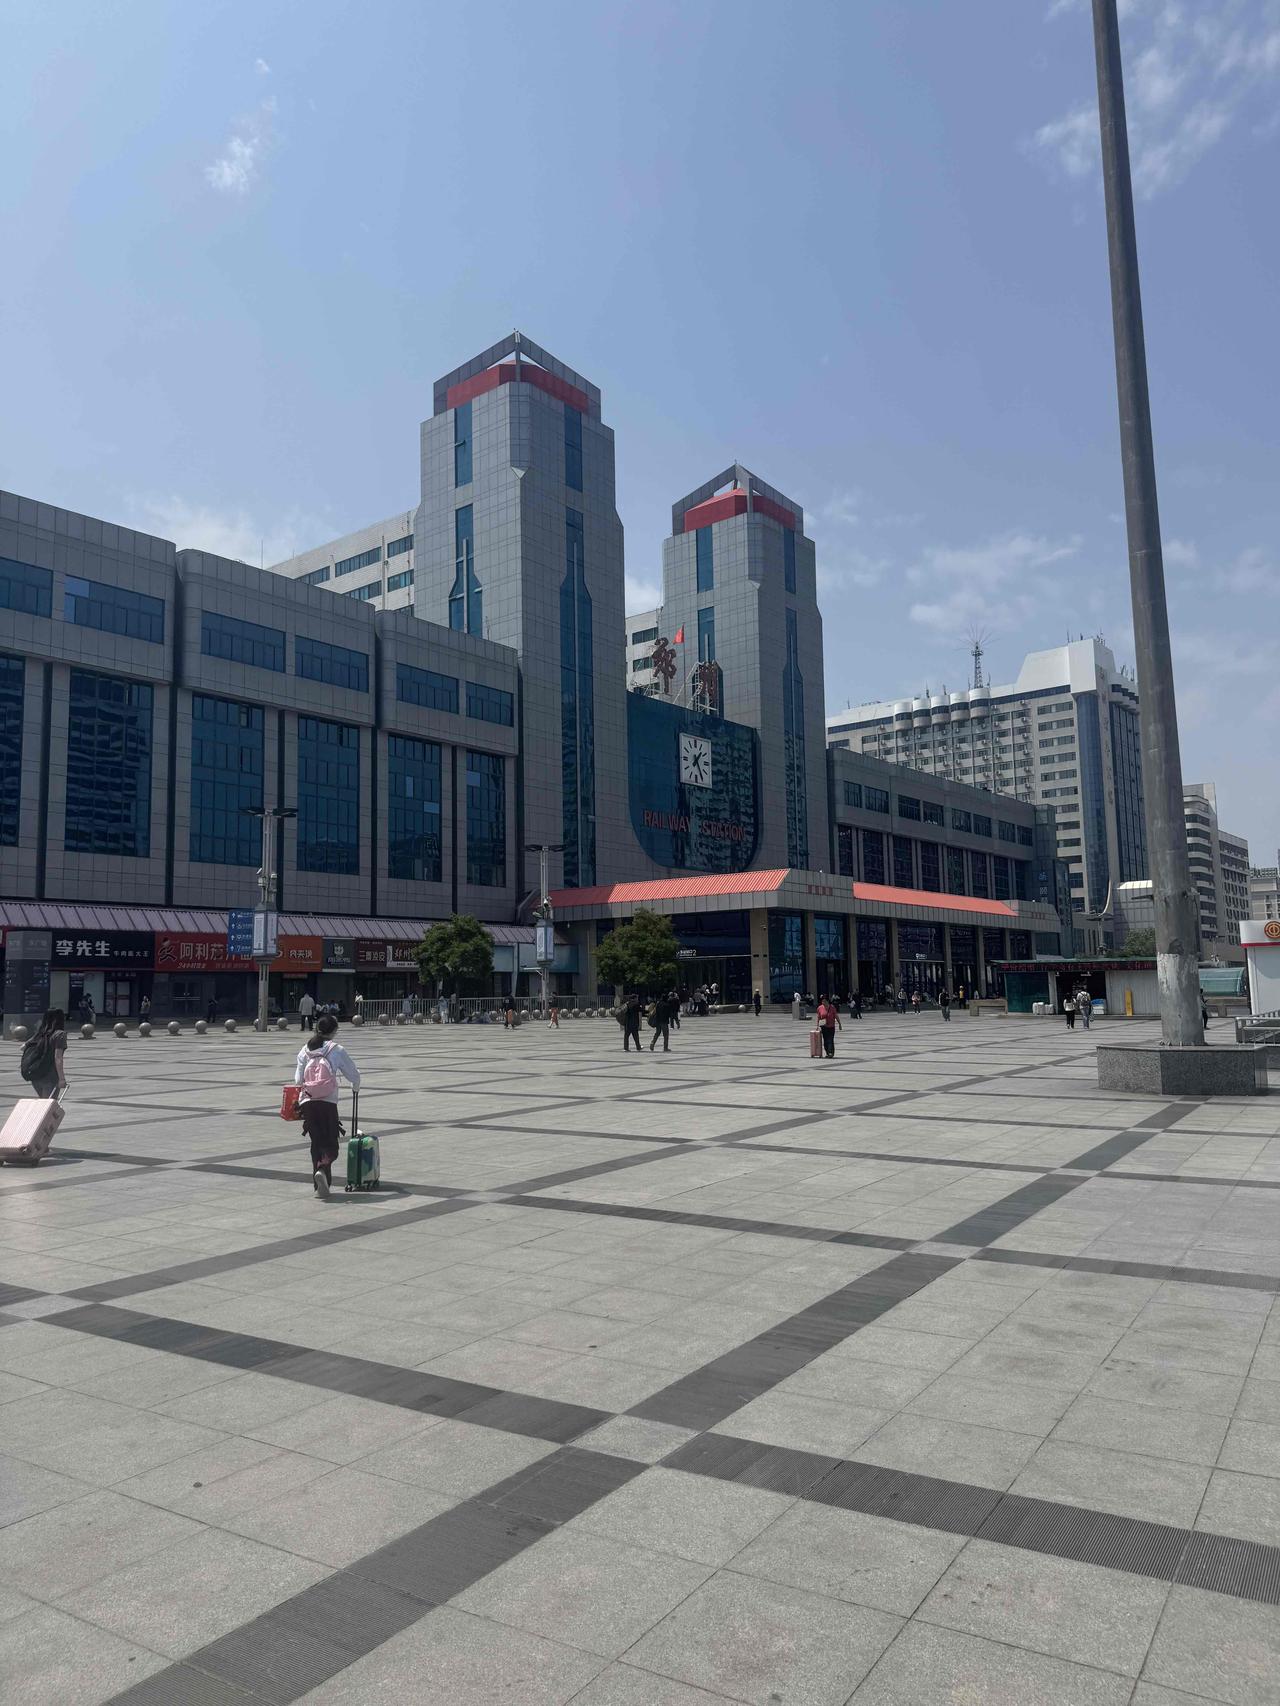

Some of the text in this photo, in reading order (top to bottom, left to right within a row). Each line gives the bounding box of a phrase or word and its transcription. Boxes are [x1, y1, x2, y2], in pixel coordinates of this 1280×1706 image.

[644, 809, 746, 841] RAILWAY STATION
[55, 939, 111, 957] 李先生
